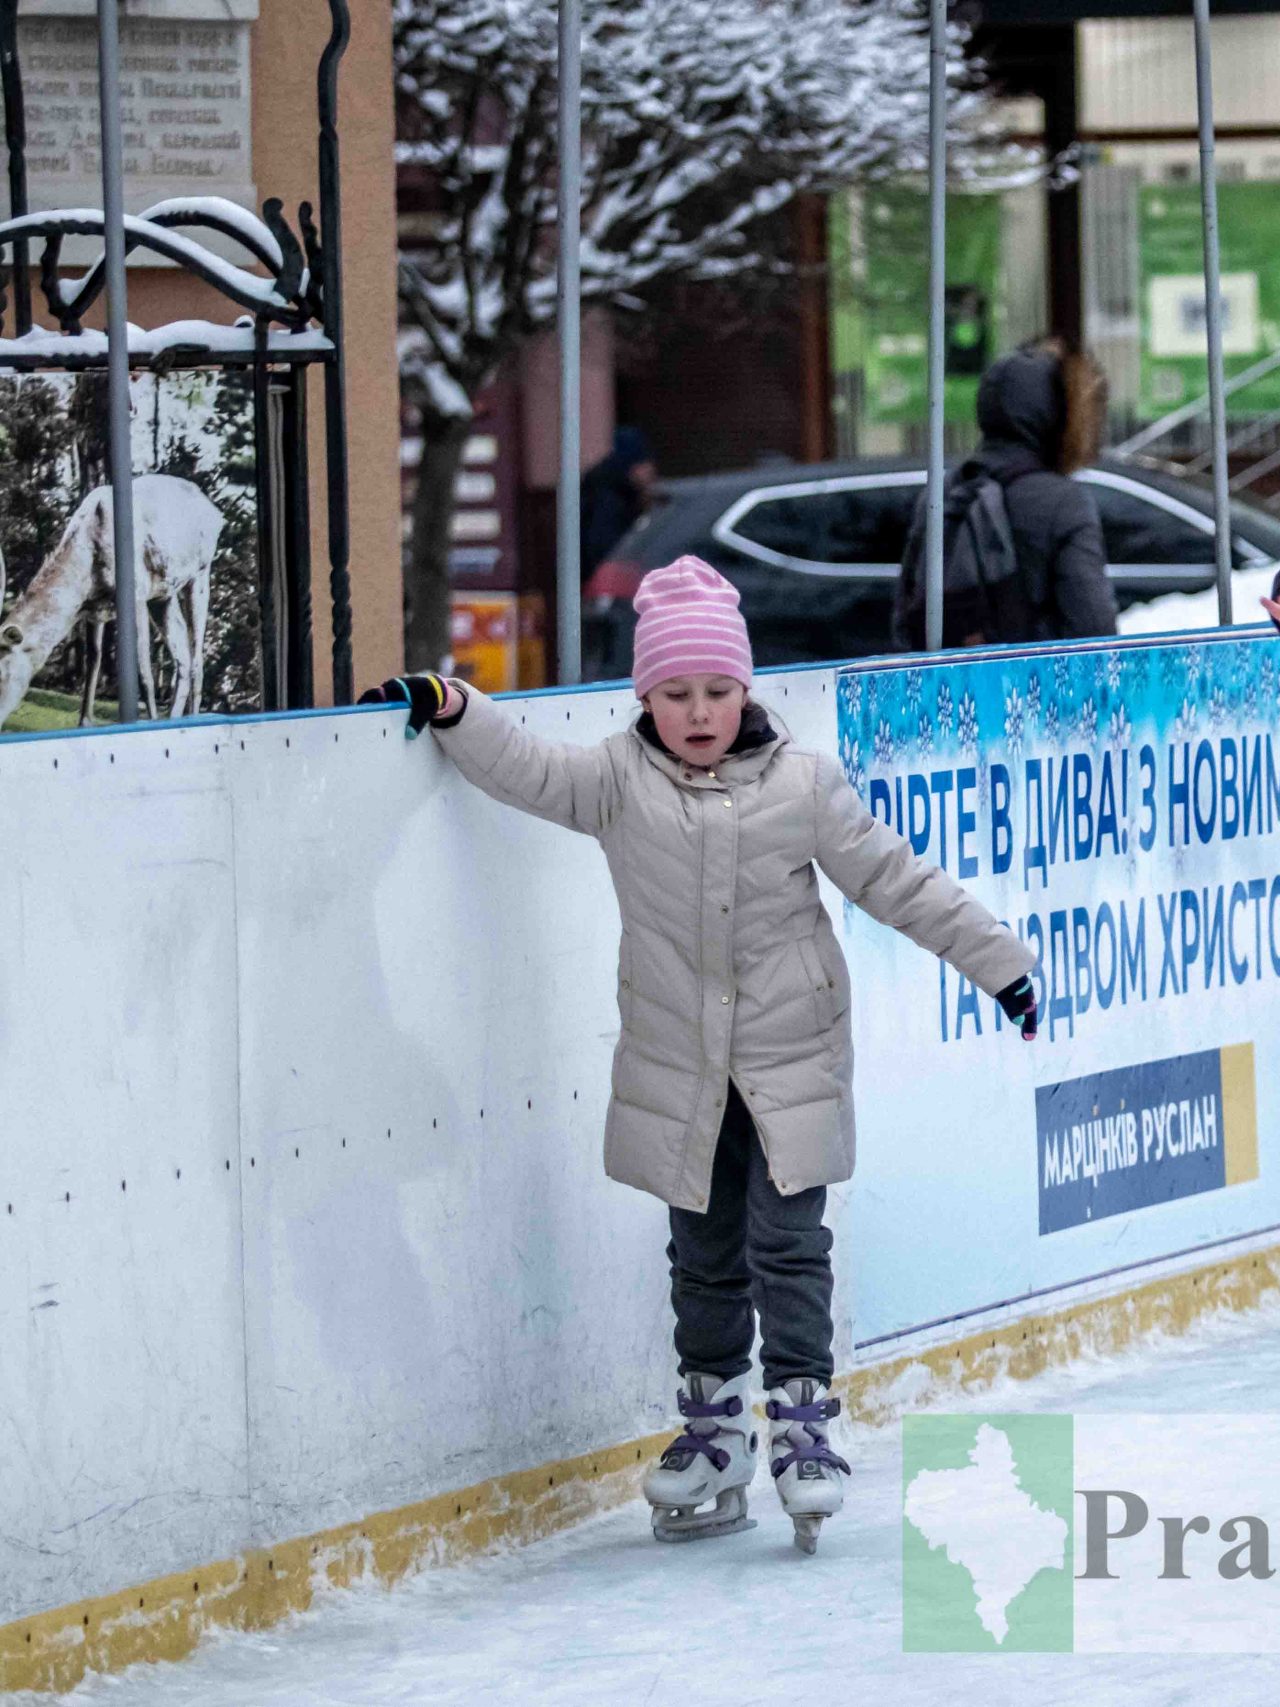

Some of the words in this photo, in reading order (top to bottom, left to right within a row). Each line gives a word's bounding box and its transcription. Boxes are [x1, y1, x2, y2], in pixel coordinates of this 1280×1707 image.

[990, 763, 1013, 875] В
[1024, 749, 1129, 891] ДИВА!
[1139, 744, 1157, 852] З
[995, 896, 1147, 1043] ЗДВОМ
[1043, 1098, 1139, 1189] МАРЦІНКІВ
[1141, 1094, 1217, 1163] РУСЛАН
